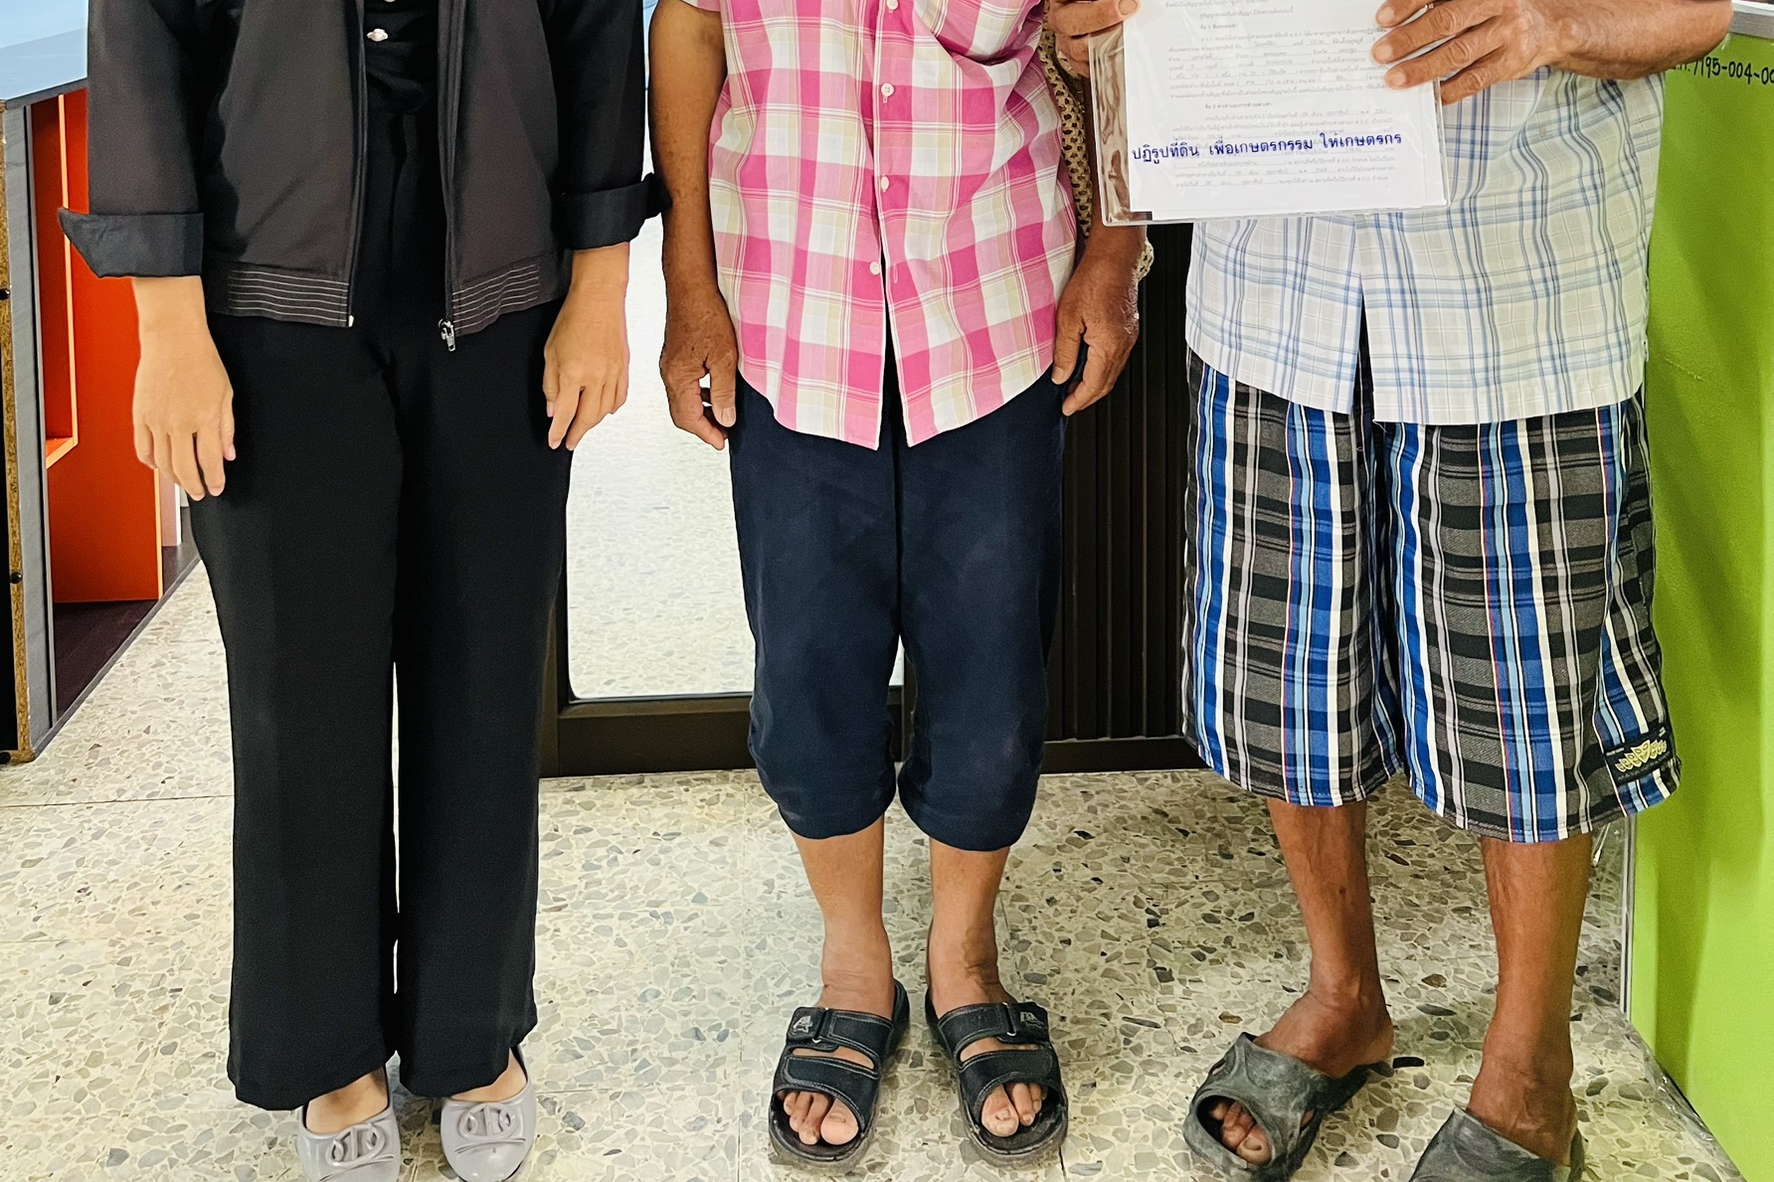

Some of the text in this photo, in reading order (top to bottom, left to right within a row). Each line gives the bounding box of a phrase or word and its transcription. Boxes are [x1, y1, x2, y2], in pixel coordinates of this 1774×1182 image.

[1132, 131, 1402, 164] ปฏิรูปที่ดิน เพื่อเกษตรกรรม ให้เกษตรกร
